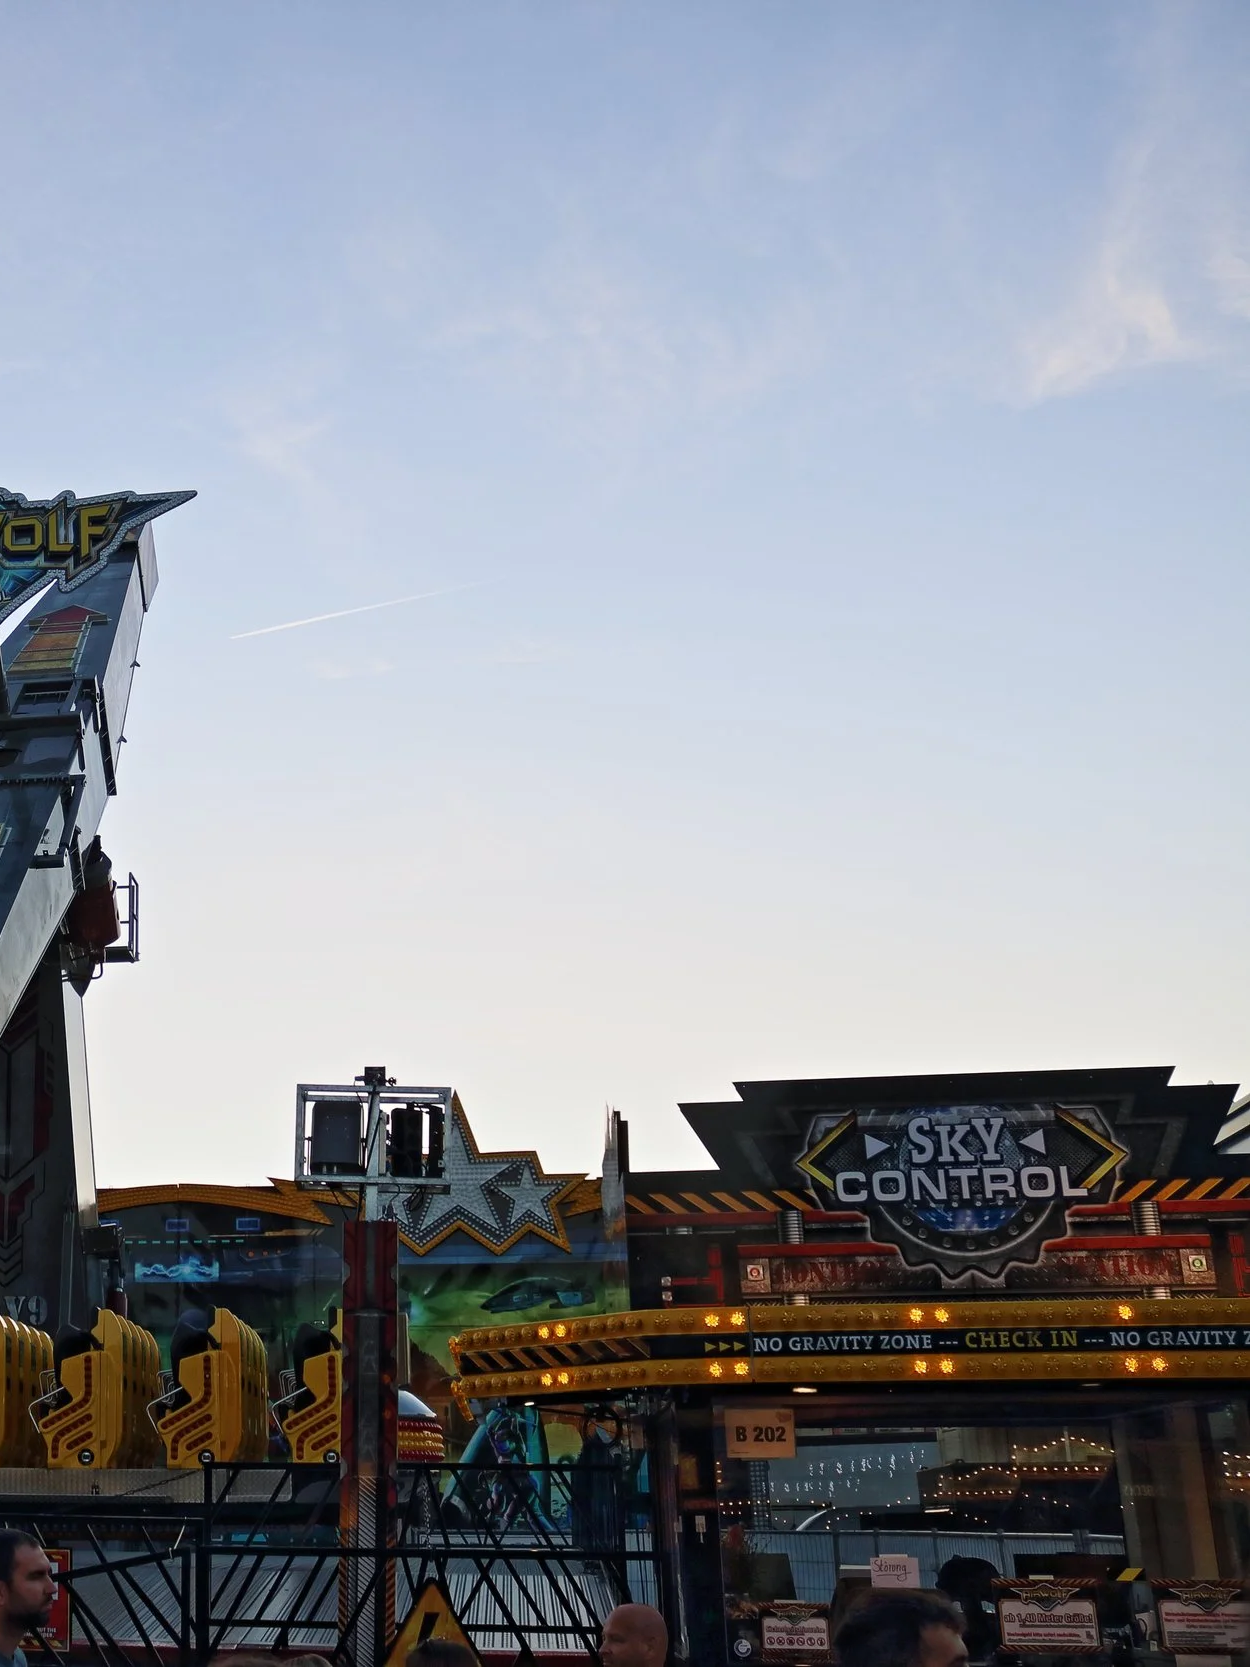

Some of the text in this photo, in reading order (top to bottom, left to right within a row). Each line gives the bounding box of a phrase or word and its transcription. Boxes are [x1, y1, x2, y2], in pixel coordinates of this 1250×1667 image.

[907, 1117, 1004, 1164] SKY
[835, 1165, 1088, 1203] CONTROL
[753, 1337, 783, 1352] NO
[788, 1335, 874, 1351] GRAVITY
[880, 1334, 932, 1349] ZONE
[965, 1331, 1043, 1348] CHECK
[1051, 1330, 1077, 1347] IN
[1110, 1331, 1141, 1347] NO
[1147, 1330, 1237, 1346] GRAVITY
[735, 1426, 787, 1442] B 202
[1004, 1612, 1094, 1624] ab 1,40 Meter Größe!
